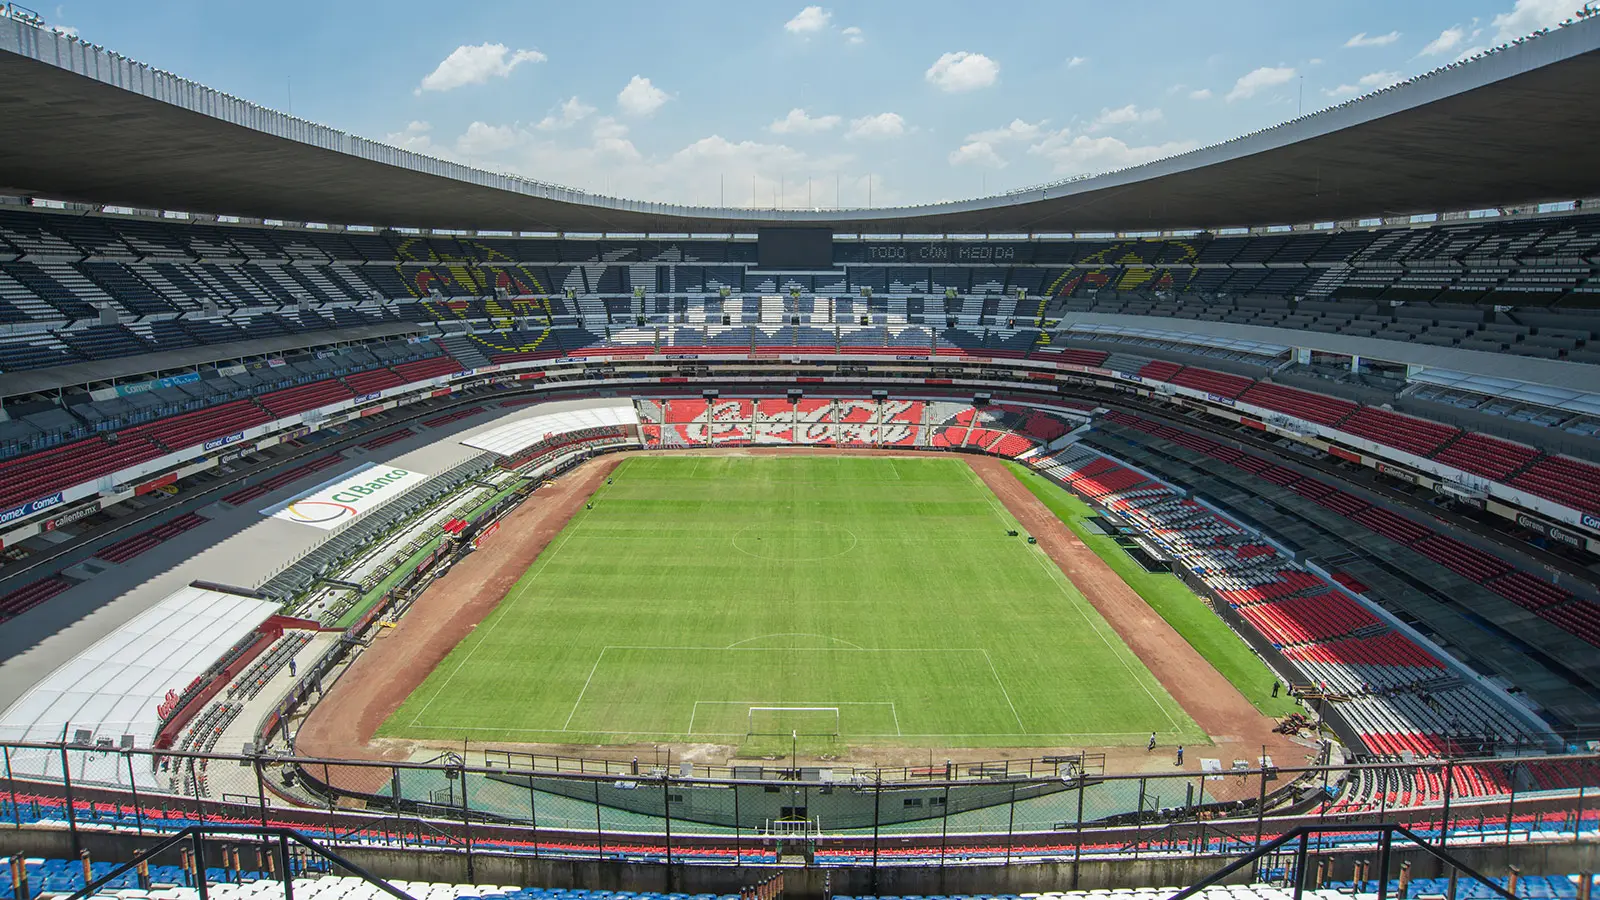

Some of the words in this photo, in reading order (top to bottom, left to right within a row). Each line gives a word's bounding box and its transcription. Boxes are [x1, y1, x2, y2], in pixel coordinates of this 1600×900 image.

[869, 246, 906, 258] TODO
[124, 381, 153, 394] Comex
[205, 438, 224, 450] Comex
[225, 433, 243, 444] Comex
[1384, 466, 1414, 482] caliente.mx
[32, 493, 60, 510] Comex
[54, 505, 97, 528] caliente.mx
[1519, 515, 1546, 534] Corona
[1550, 527, 1579, 547] Corona
